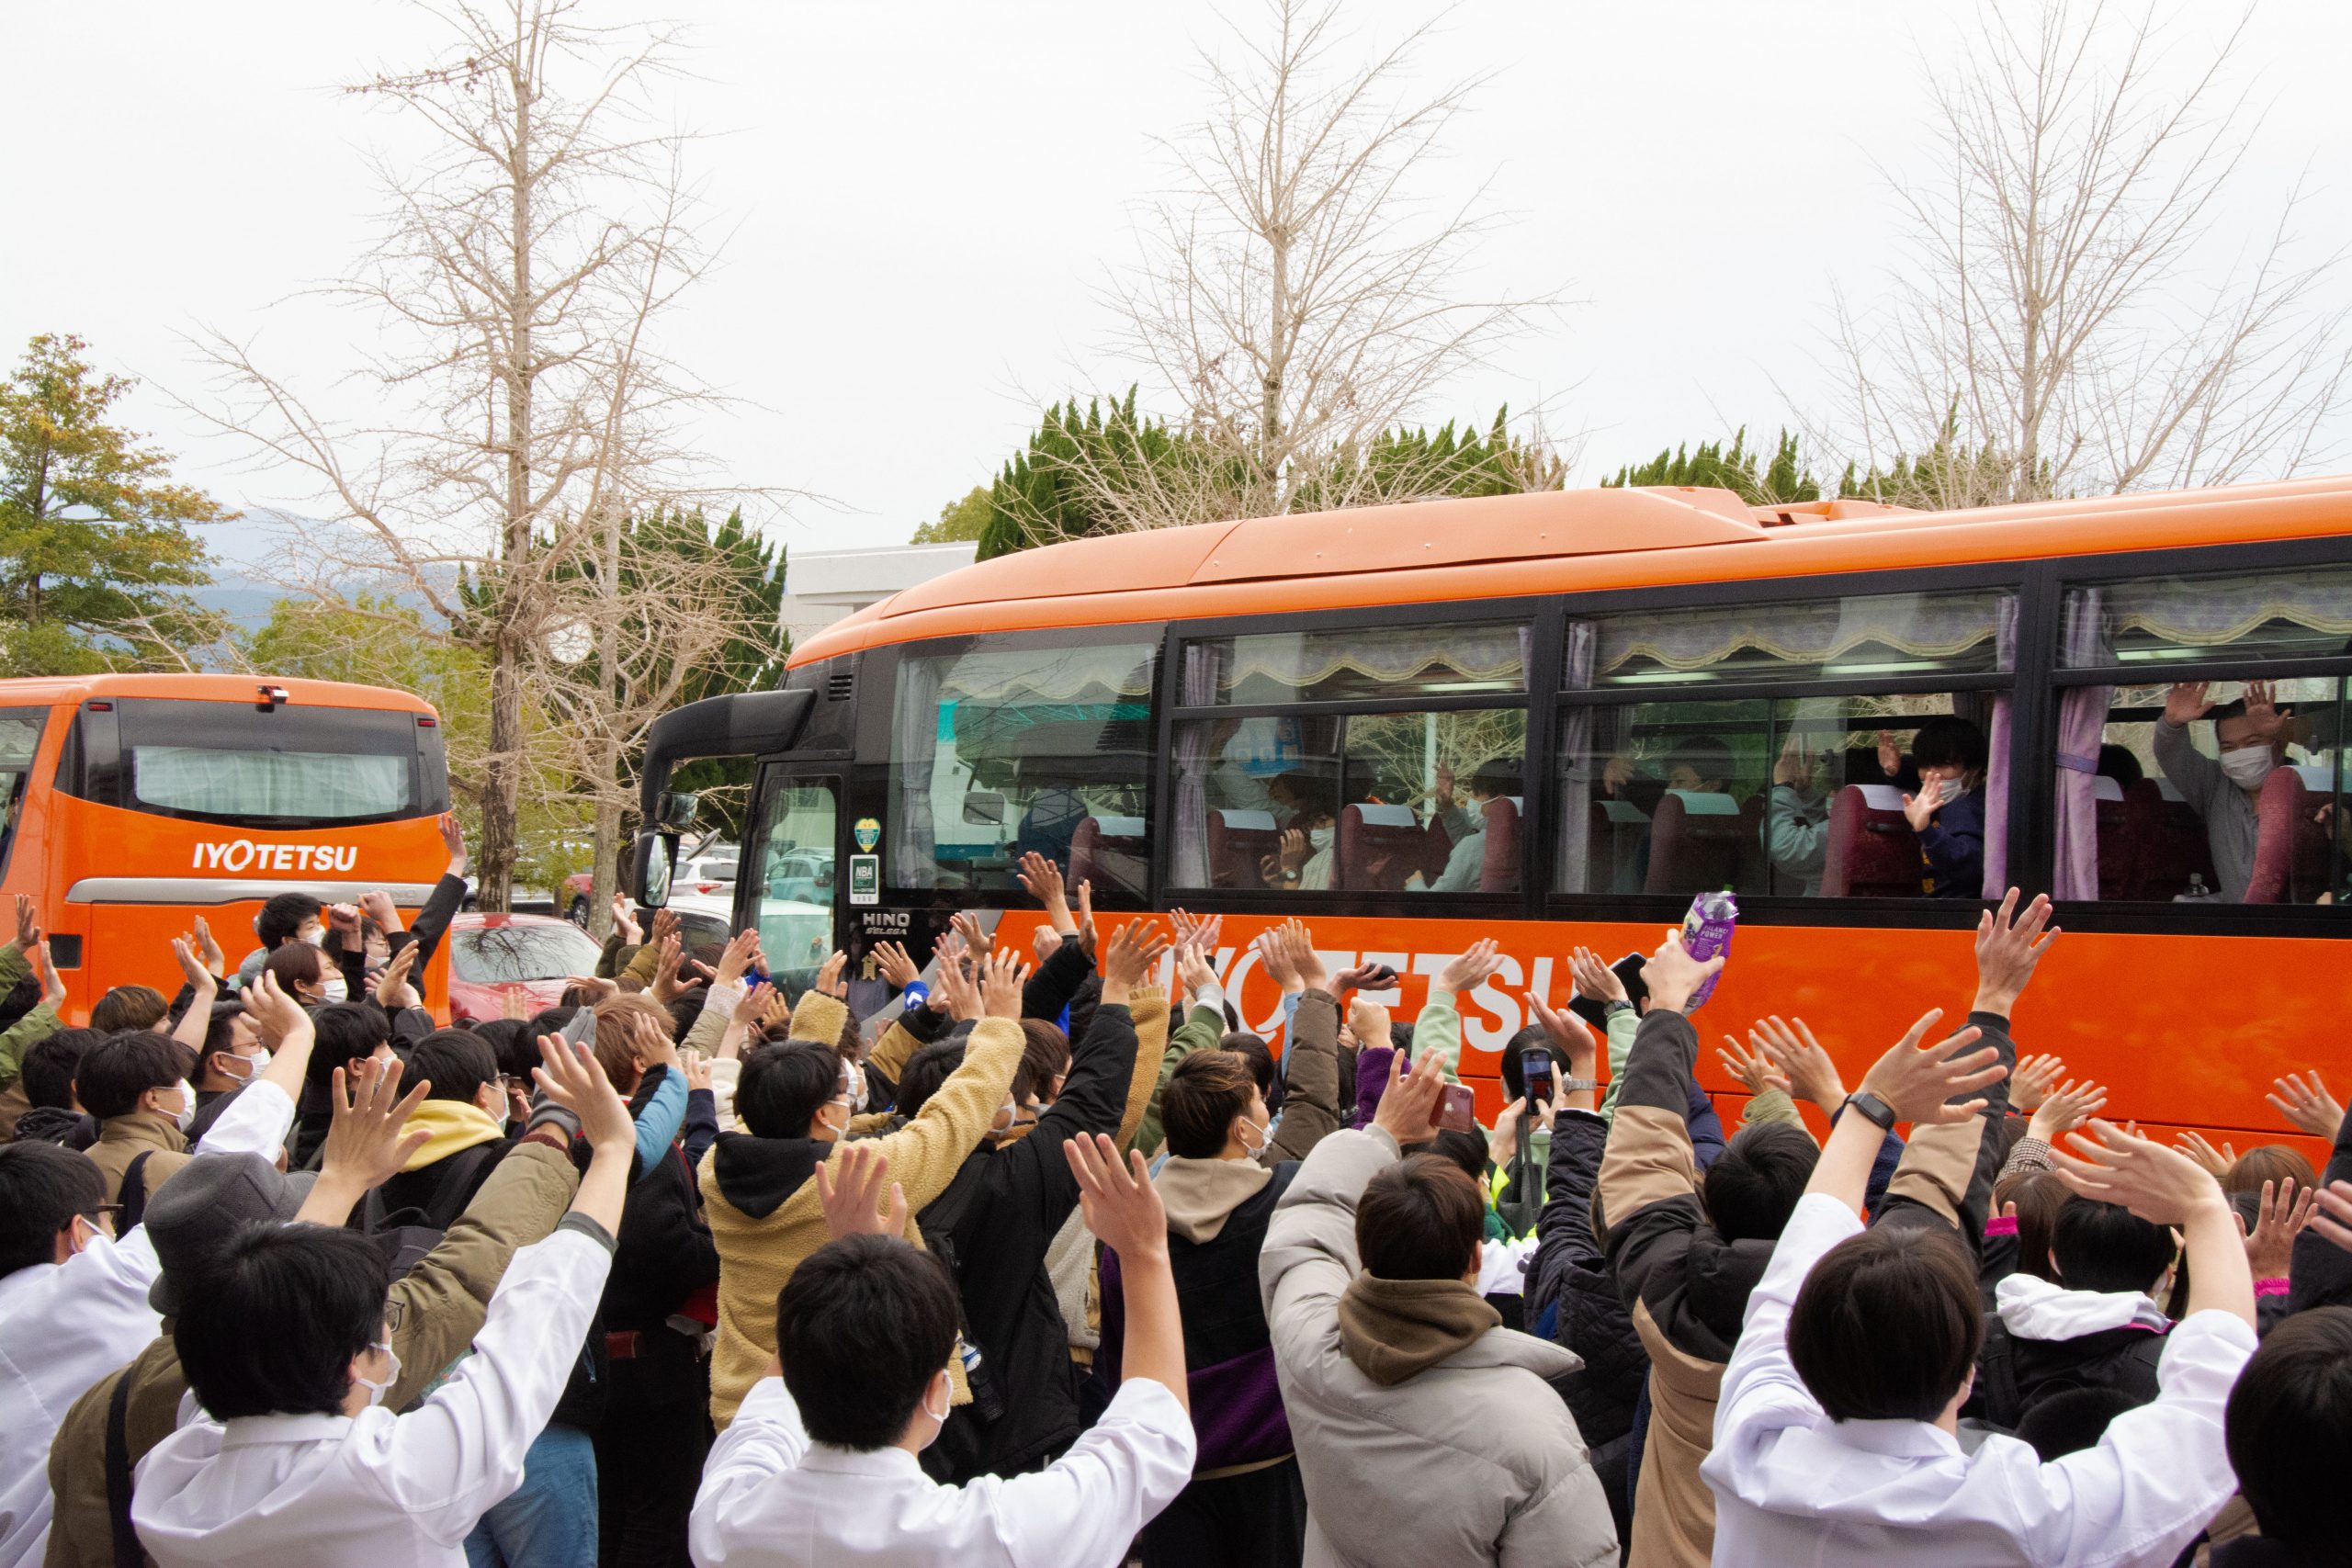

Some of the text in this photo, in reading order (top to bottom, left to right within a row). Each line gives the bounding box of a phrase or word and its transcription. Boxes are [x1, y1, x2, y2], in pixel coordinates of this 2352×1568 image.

[192, 840, 357, 872] IYOTETSU
[855, 866, 873, 877] NBA
[863, 913, 910, 927] HINO
[1700, 930, 1723, 939] POWER
